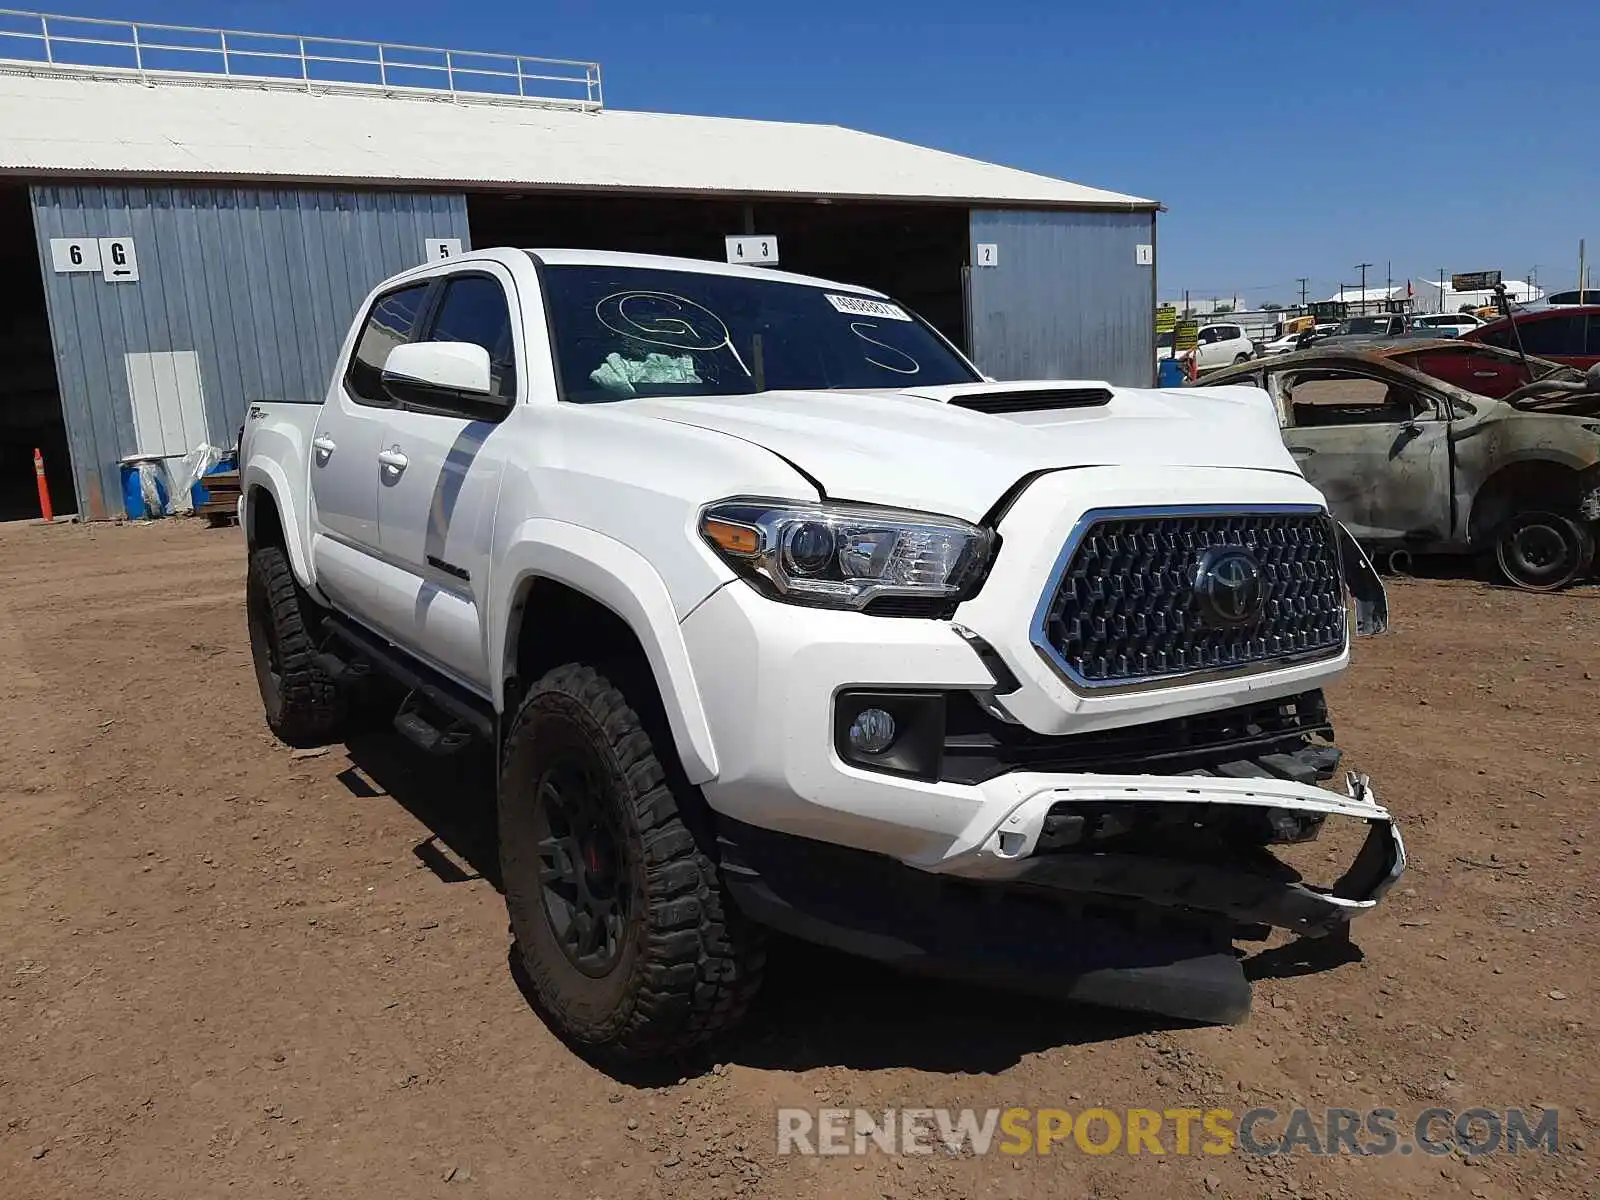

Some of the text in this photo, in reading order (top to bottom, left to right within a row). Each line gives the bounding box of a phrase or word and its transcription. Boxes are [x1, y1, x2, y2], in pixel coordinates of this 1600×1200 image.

[69, 245, 83, 265] 6
[111, 242, 126, 265] G
[439, 244, 449, 258] 5
[736, 242, 769, 257] 4 3
[985, 248, 990, 262] 2
